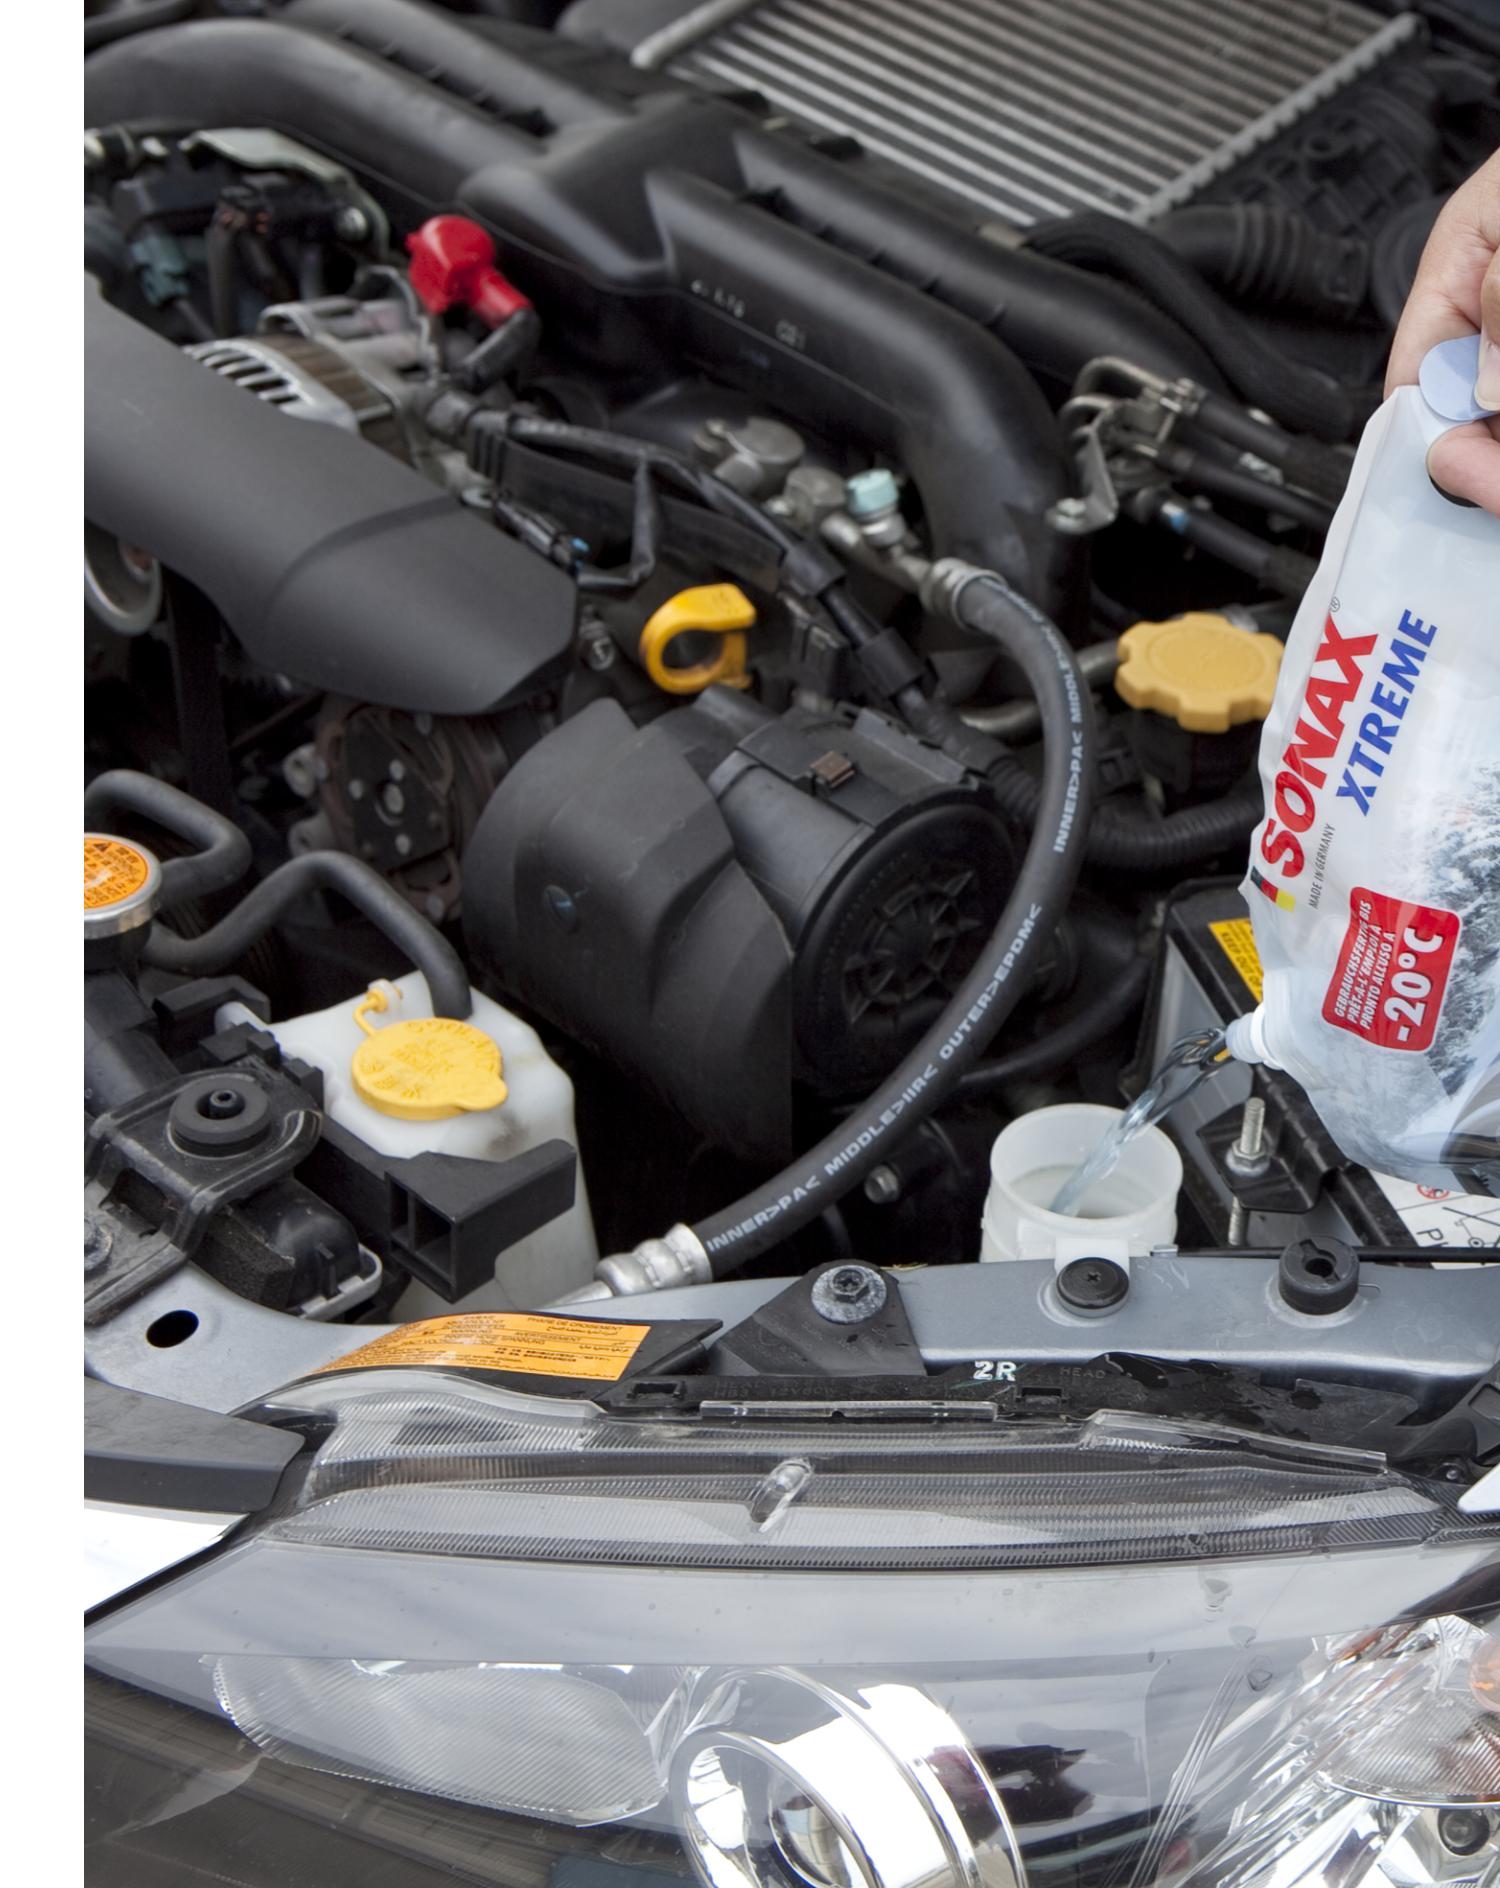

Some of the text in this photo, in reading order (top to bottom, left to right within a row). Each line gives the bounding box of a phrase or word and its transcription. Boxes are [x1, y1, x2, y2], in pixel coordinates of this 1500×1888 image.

[1264, 613, 1377, 875] SONAX
[1336, 608, 1439, 816] XTREME
[1309, 823, 1335, 908] MADE IN GERMANY
[1360, 900, 1372, 919] BIS
[1360, 984, 1381, 1029] PRONTO
[973, 1360, 1017, 1381] 2R
